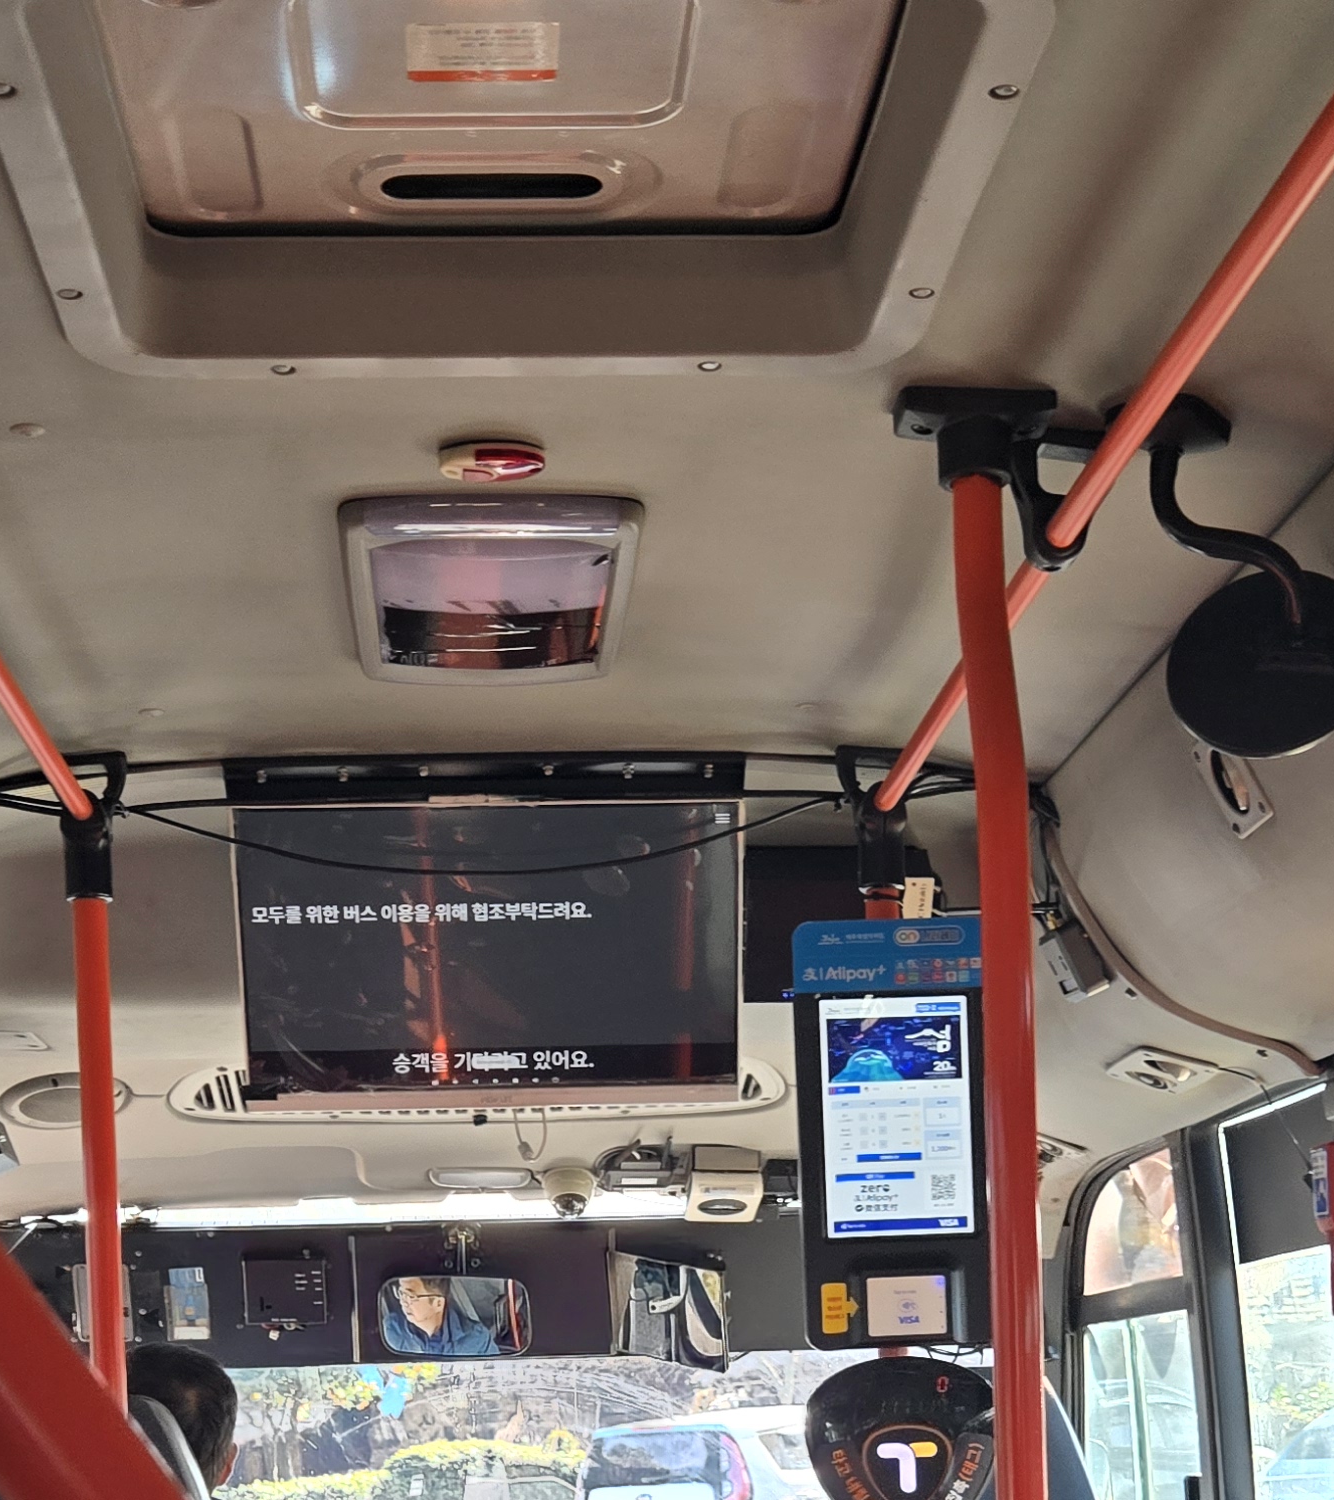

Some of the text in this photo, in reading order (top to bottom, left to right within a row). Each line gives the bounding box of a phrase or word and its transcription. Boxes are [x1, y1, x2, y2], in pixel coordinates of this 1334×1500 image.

[250, 901, 593, 925] 모두를 위한 버스 이용을 위해 협조부탁드려요.
[824, 964, 887, 983] Alipay+
[391, 1052, 449, 1074] 승객을
[532, 1050, 596, 1070] 있어요.
[898, 1315, 920, 1325] VISA
[830, 1447, 851, 1479] 타고
